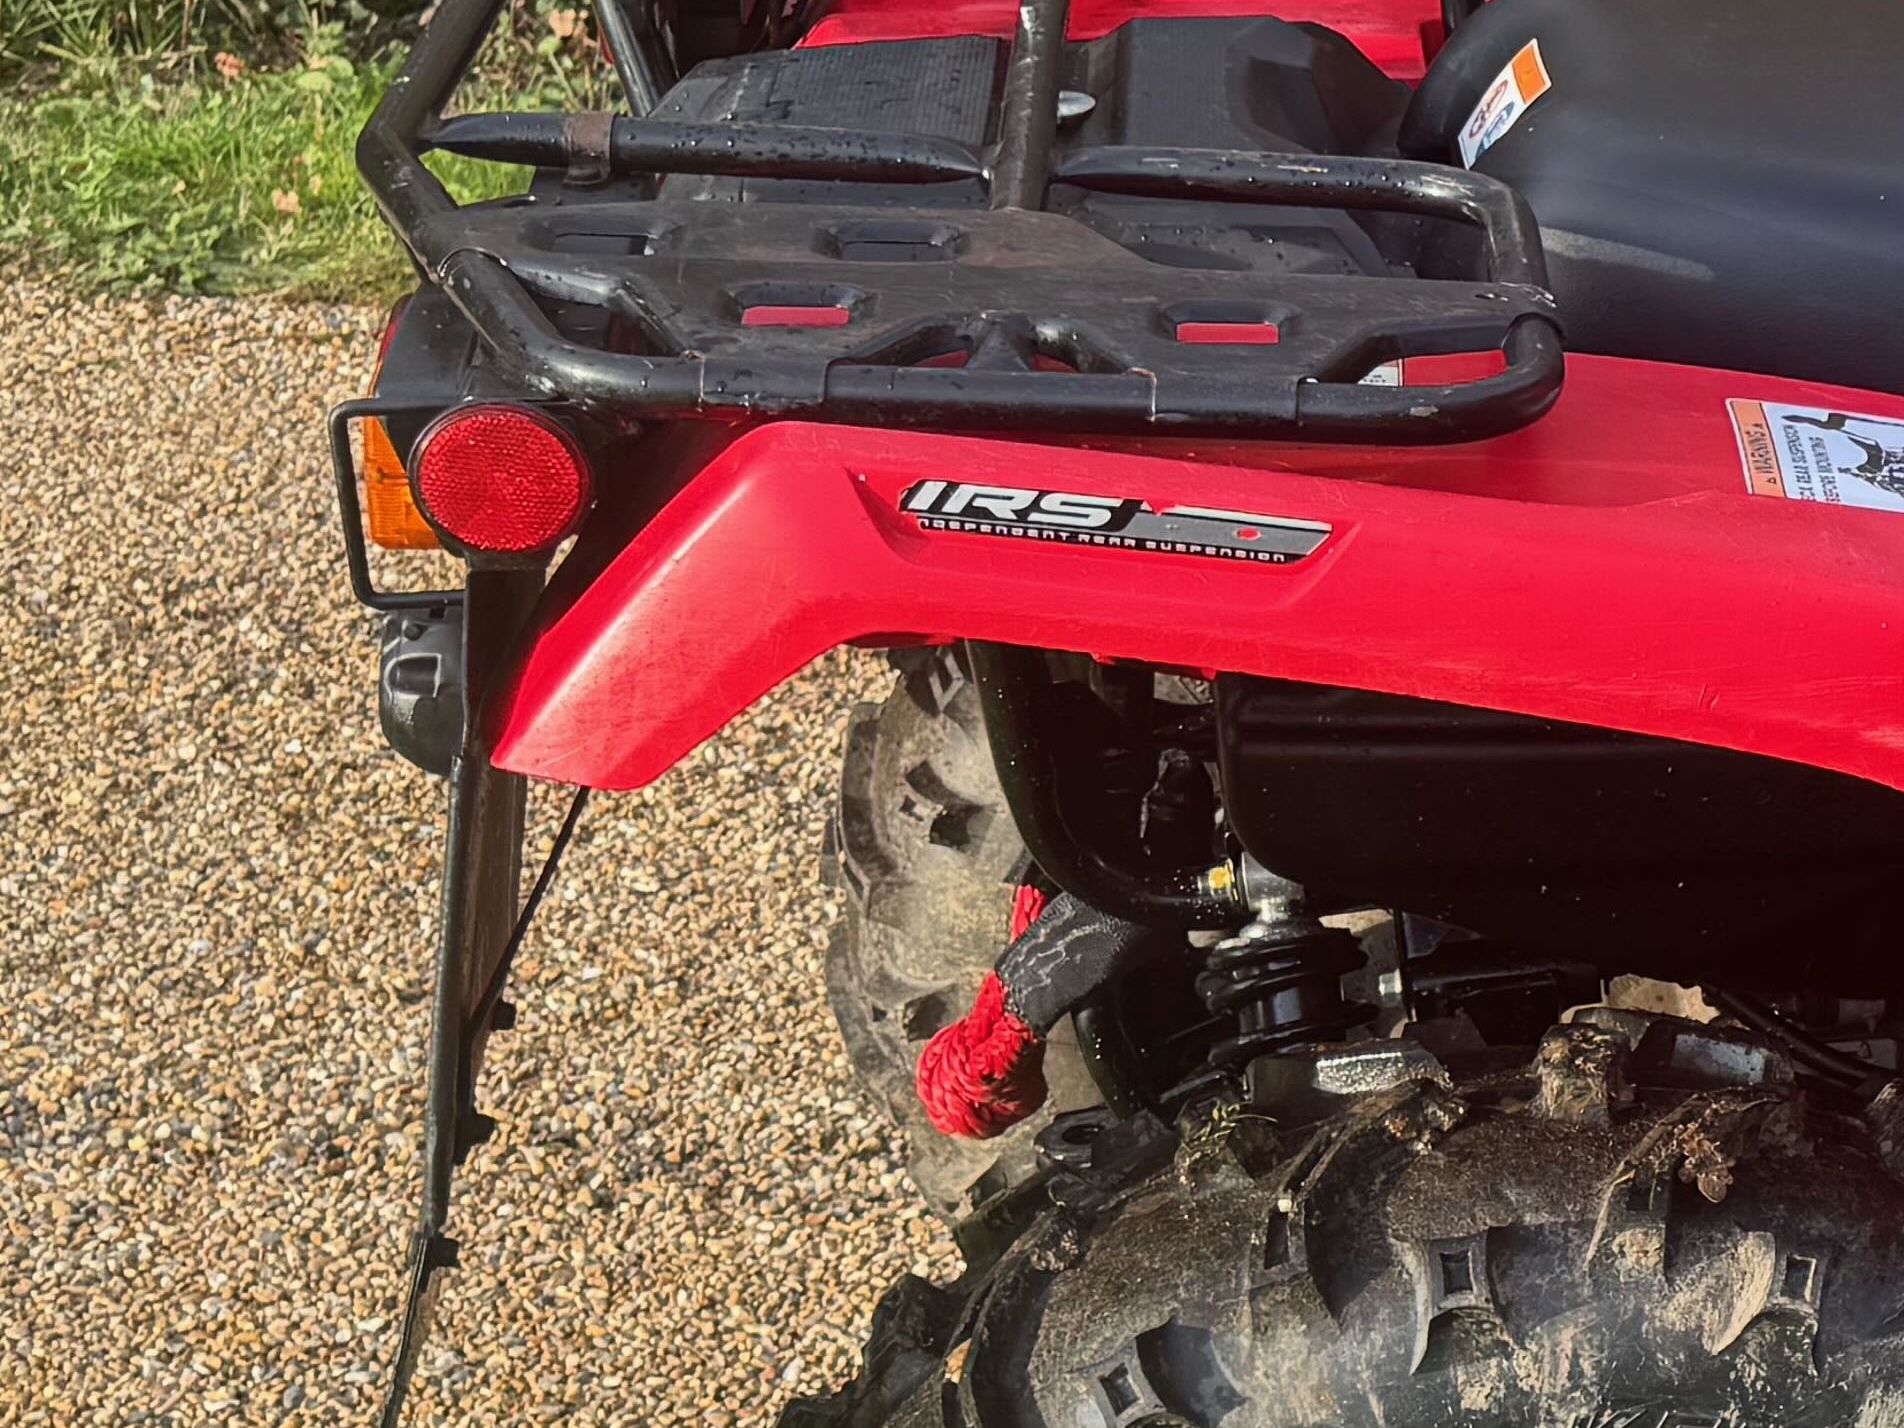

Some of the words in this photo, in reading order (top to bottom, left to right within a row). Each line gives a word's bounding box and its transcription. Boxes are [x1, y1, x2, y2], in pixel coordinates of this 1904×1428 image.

[907, 481, 1125, 528] IRS
[918, 518, 1070, 541] NDEPENDENT
[1078, 533, 1136, 548] REAR
